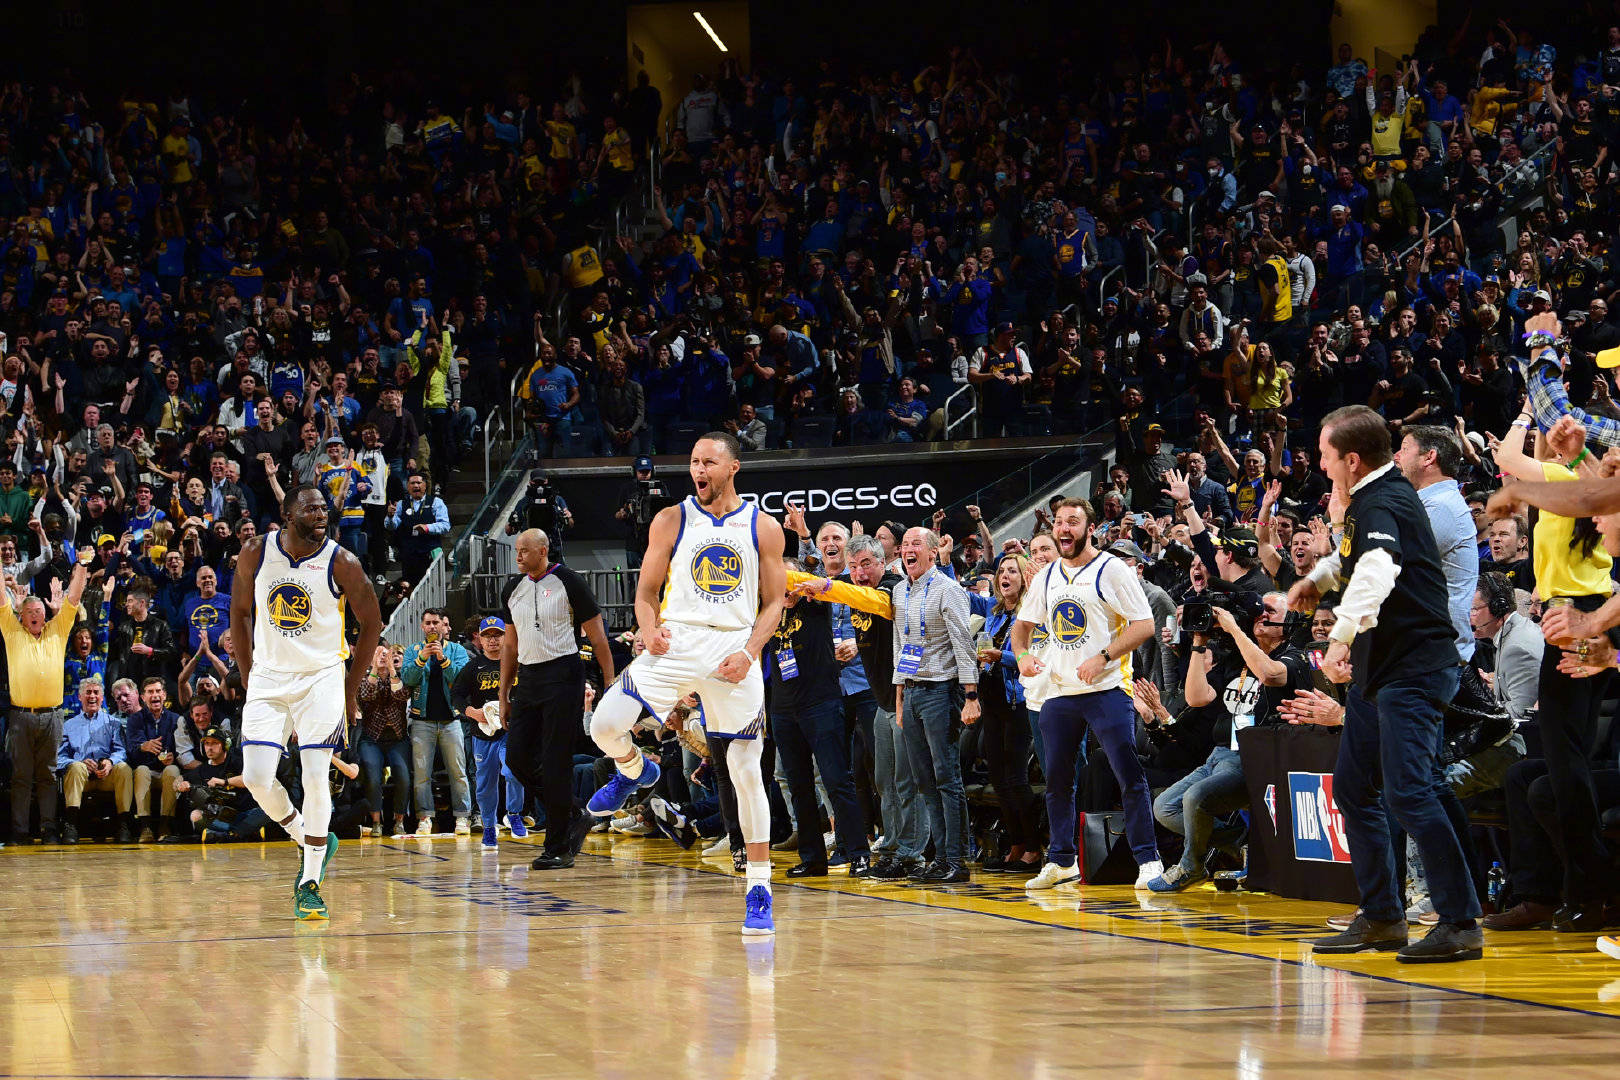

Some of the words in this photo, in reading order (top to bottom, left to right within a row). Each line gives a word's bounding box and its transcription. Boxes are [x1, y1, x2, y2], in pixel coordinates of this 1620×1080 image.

[719, 556, 738, 571] 30
[694, 585, 744, 604] WARRIORS
[291, 596, 308, 610] 23
[1067, 606, 1075, 620] 5
[1295, 791, 1321, 841] NBA
